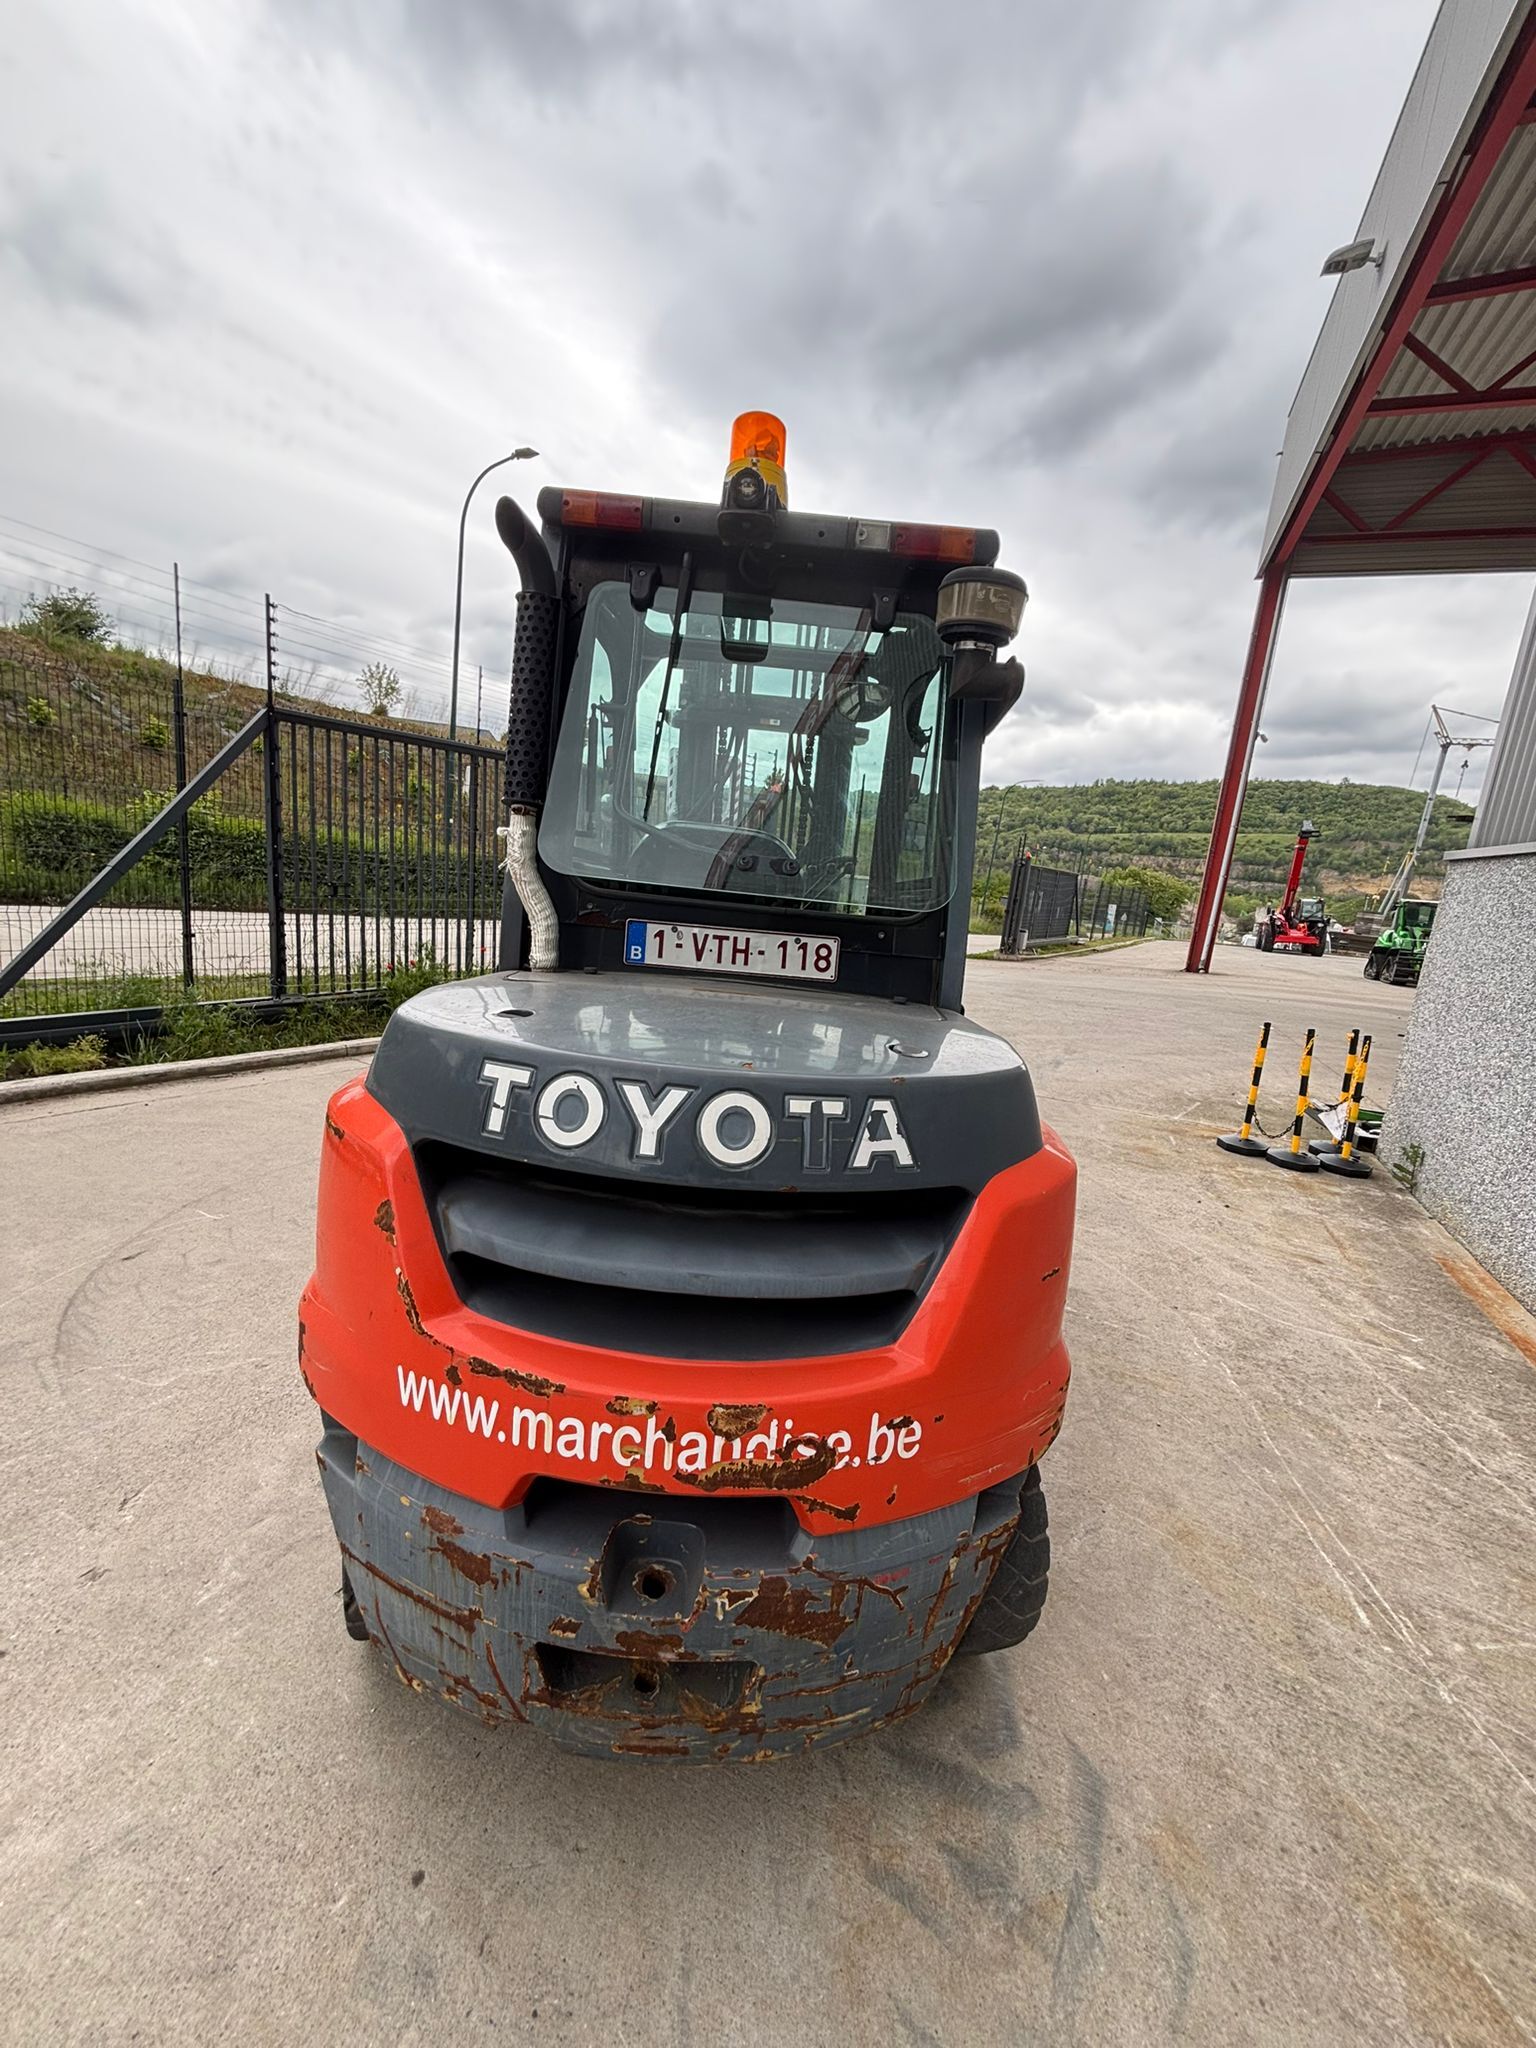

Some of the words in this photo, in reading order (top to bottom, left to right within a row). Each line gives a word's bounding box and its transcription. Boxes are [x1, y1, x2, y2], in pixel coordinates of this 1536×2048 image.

[630, 945, 643, 960] B
[653, 929, 832, 973] 1-VTH-118
[481, 1062, 915, 1169] TOYOTA
